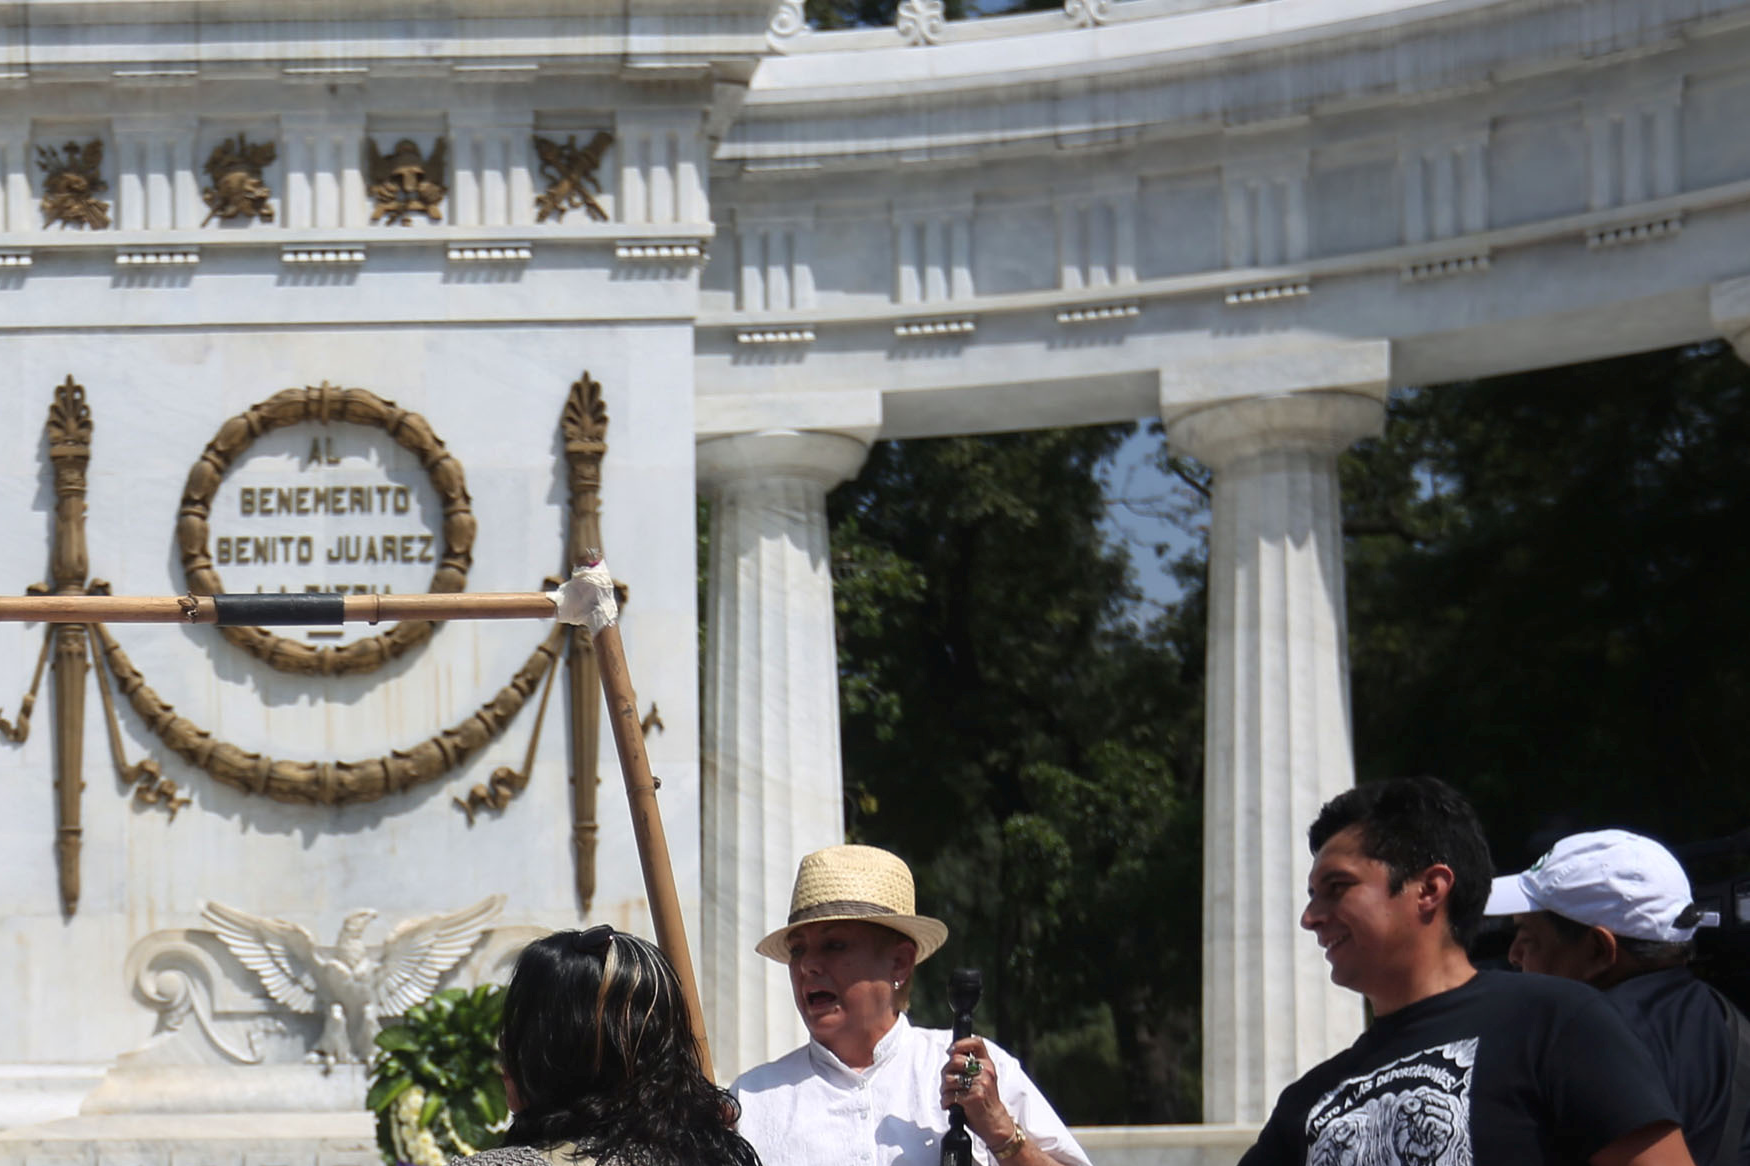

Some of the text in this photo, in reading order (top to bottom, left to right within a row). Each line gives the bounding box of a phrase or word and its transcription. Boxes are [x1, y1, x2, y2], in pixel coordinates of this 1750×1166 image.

[308, 436, 340, 465] AL
[240, 486, 410, 516] BENEMERITO
[217, 535, 435, 564] BENITO JUAREZ
